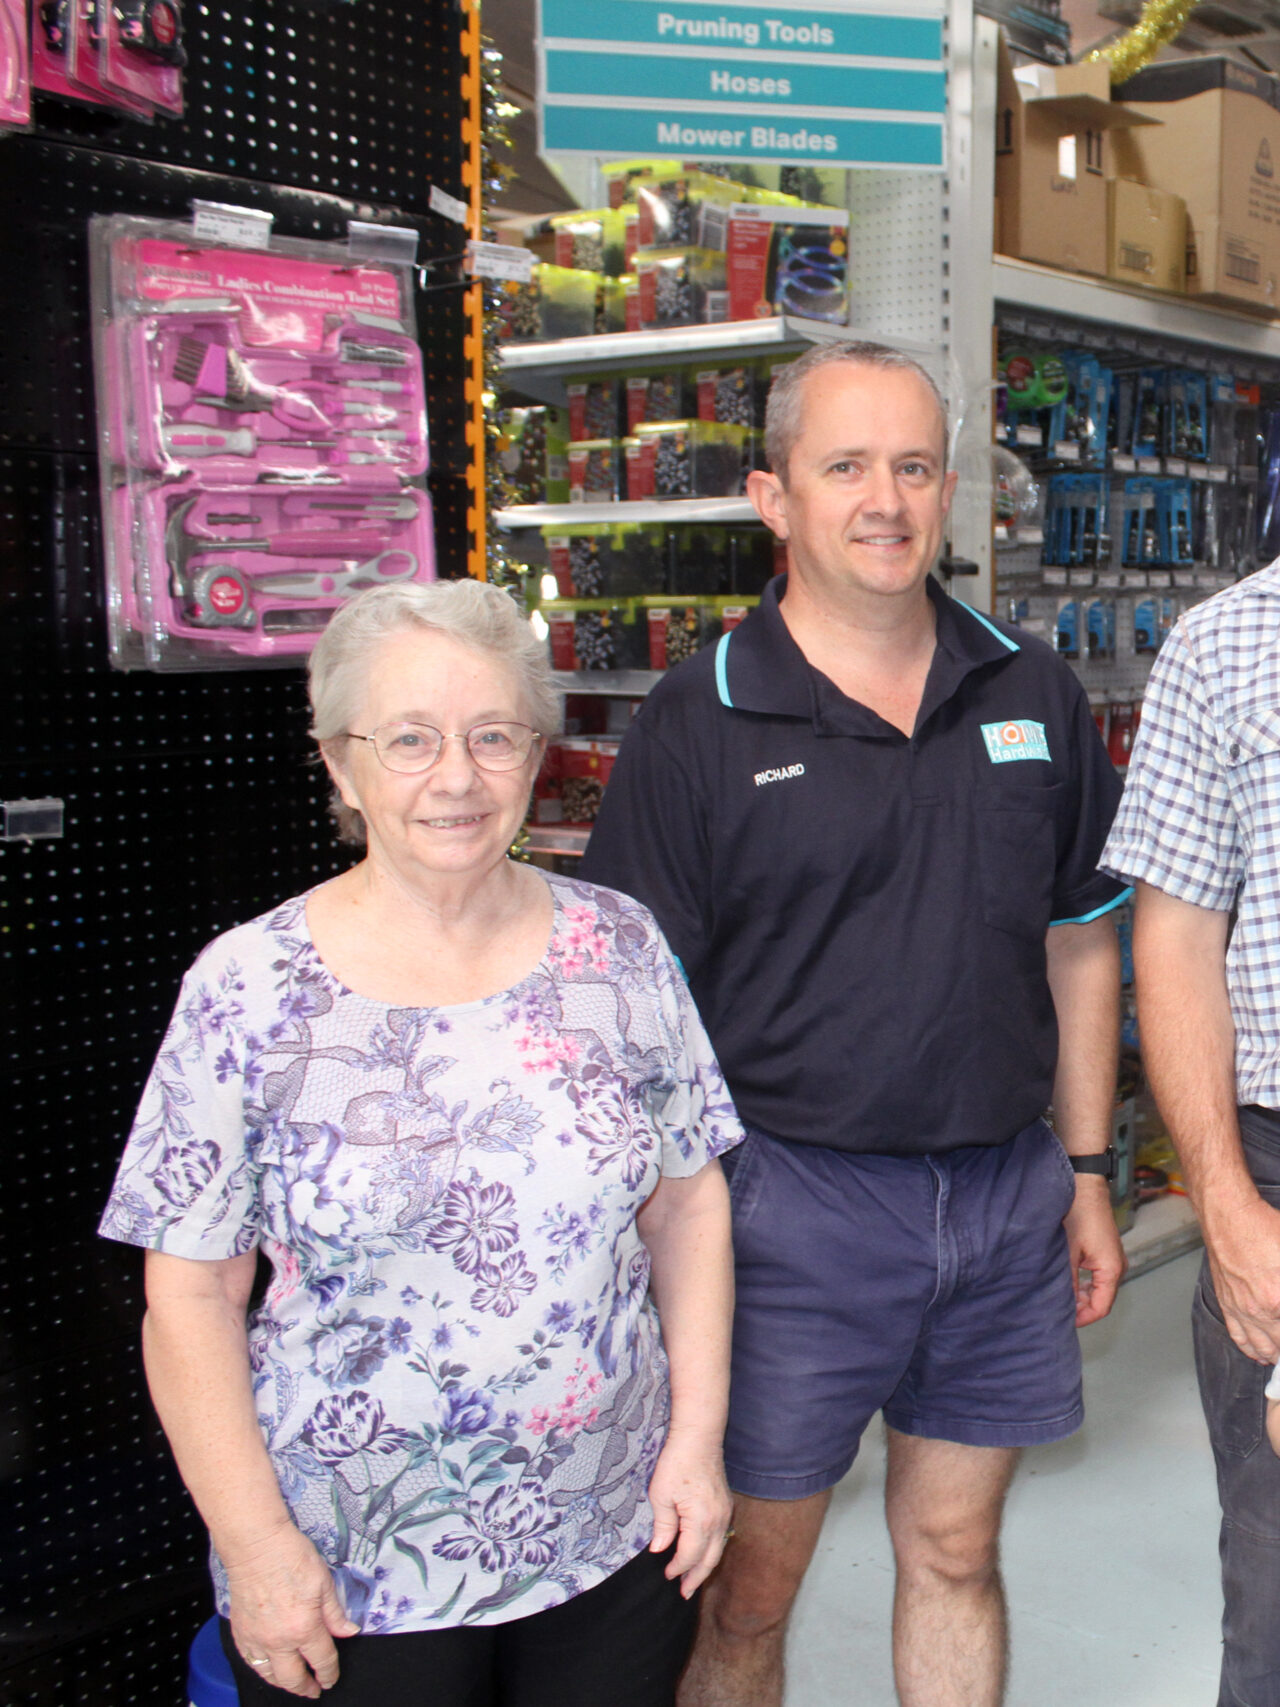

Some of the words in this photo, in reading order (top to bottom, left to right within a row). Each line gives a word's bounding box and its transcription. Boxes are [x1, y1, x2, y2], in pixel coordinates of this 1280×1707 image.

[657, 13, 760, 44] Pruning
[765, 20, 834, 45] Tools
[710, 70, 792, 96] Hoses
[657, 122, 746, 148] Mower
[750, 127, 838, 152] Blades
[216, 273, 262, 293] Ladies
[263, 280, 345, 302] Combination
[345, 290, 374, 305] Tool
[376, 294, 397, 308] Set
[983, 724, 1048, 748] HOME
[754, 763, 805, 787] RICHARD
